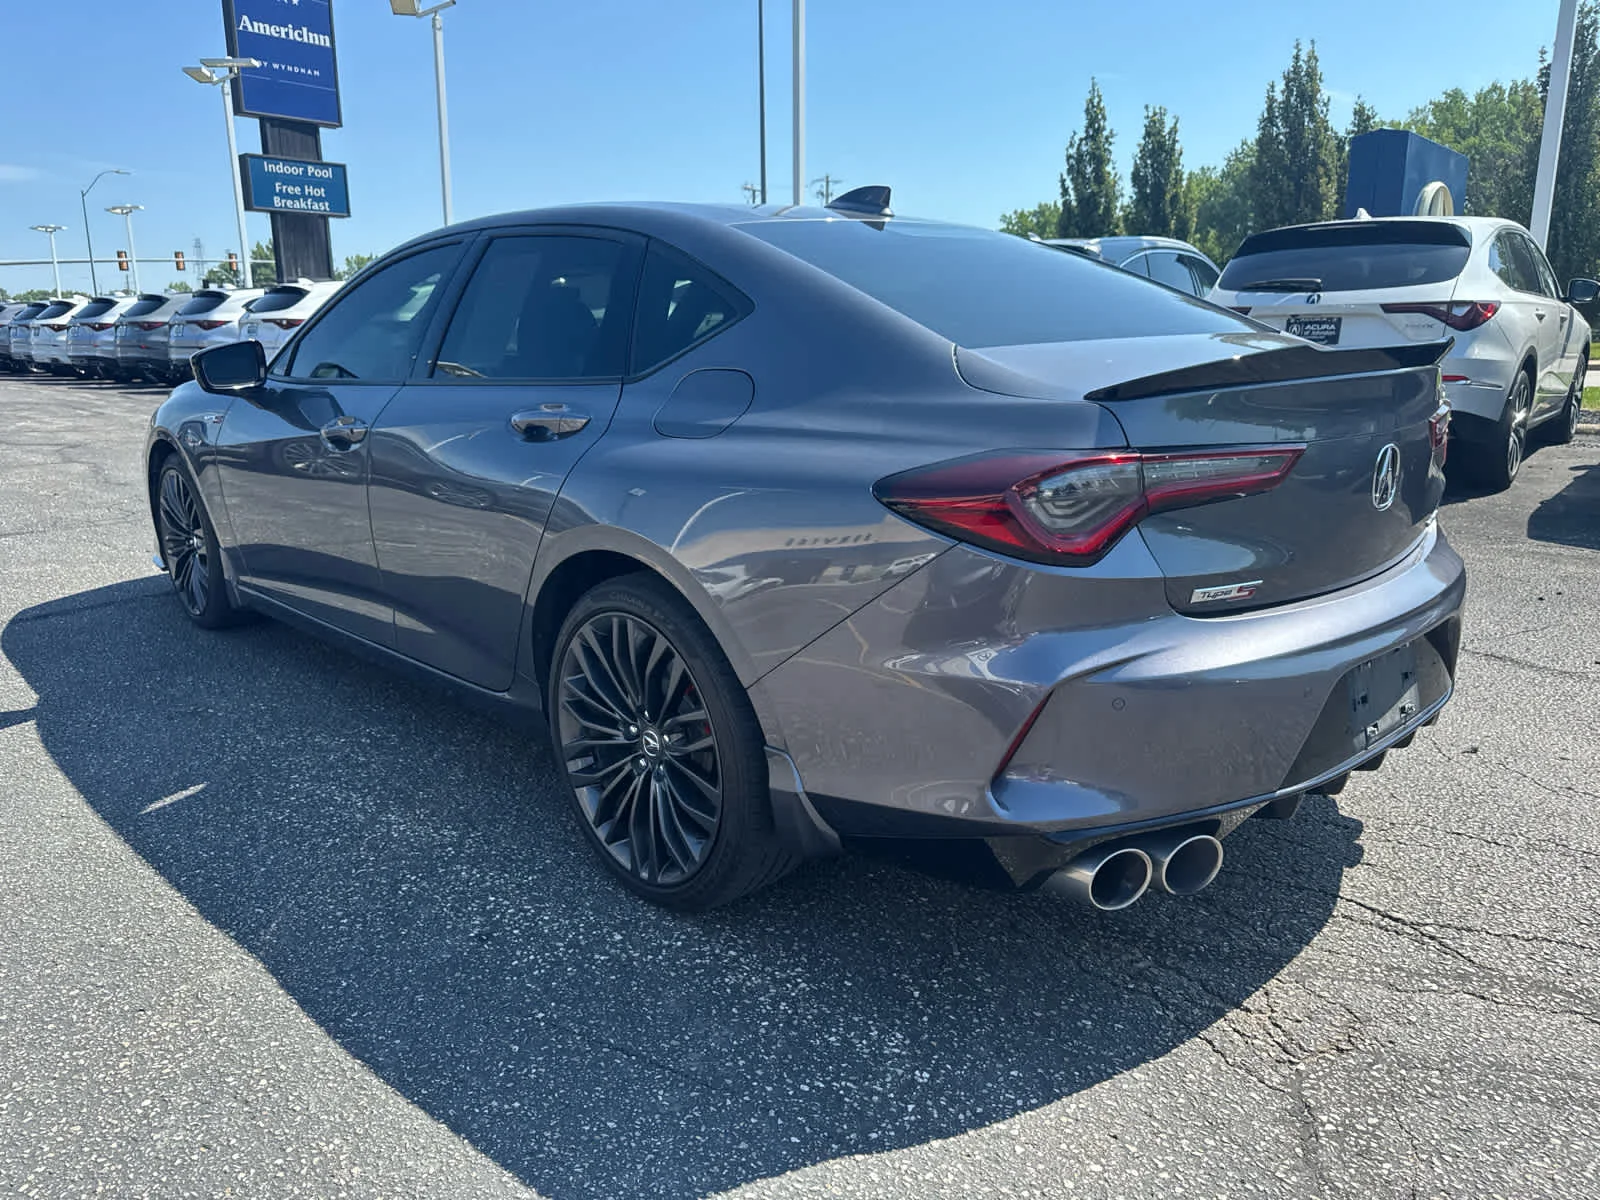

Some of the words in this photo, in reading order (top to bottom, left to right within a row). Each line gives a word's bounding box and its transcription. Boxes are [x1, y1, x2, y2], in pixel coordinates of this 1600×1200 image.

[237, 14, 332, 48] AmericInn
[272, 62, 320, 77] WYNDHAM
[263, 161, 304, 176] Indoor
[307, 165, 333, 179] Pool
[275, 182, 302, 195] Free
[304, 184, 326, 198] Hot
[273, 195, 330, 212] Breakfast
[1200, 589, 1233, 600] Type
